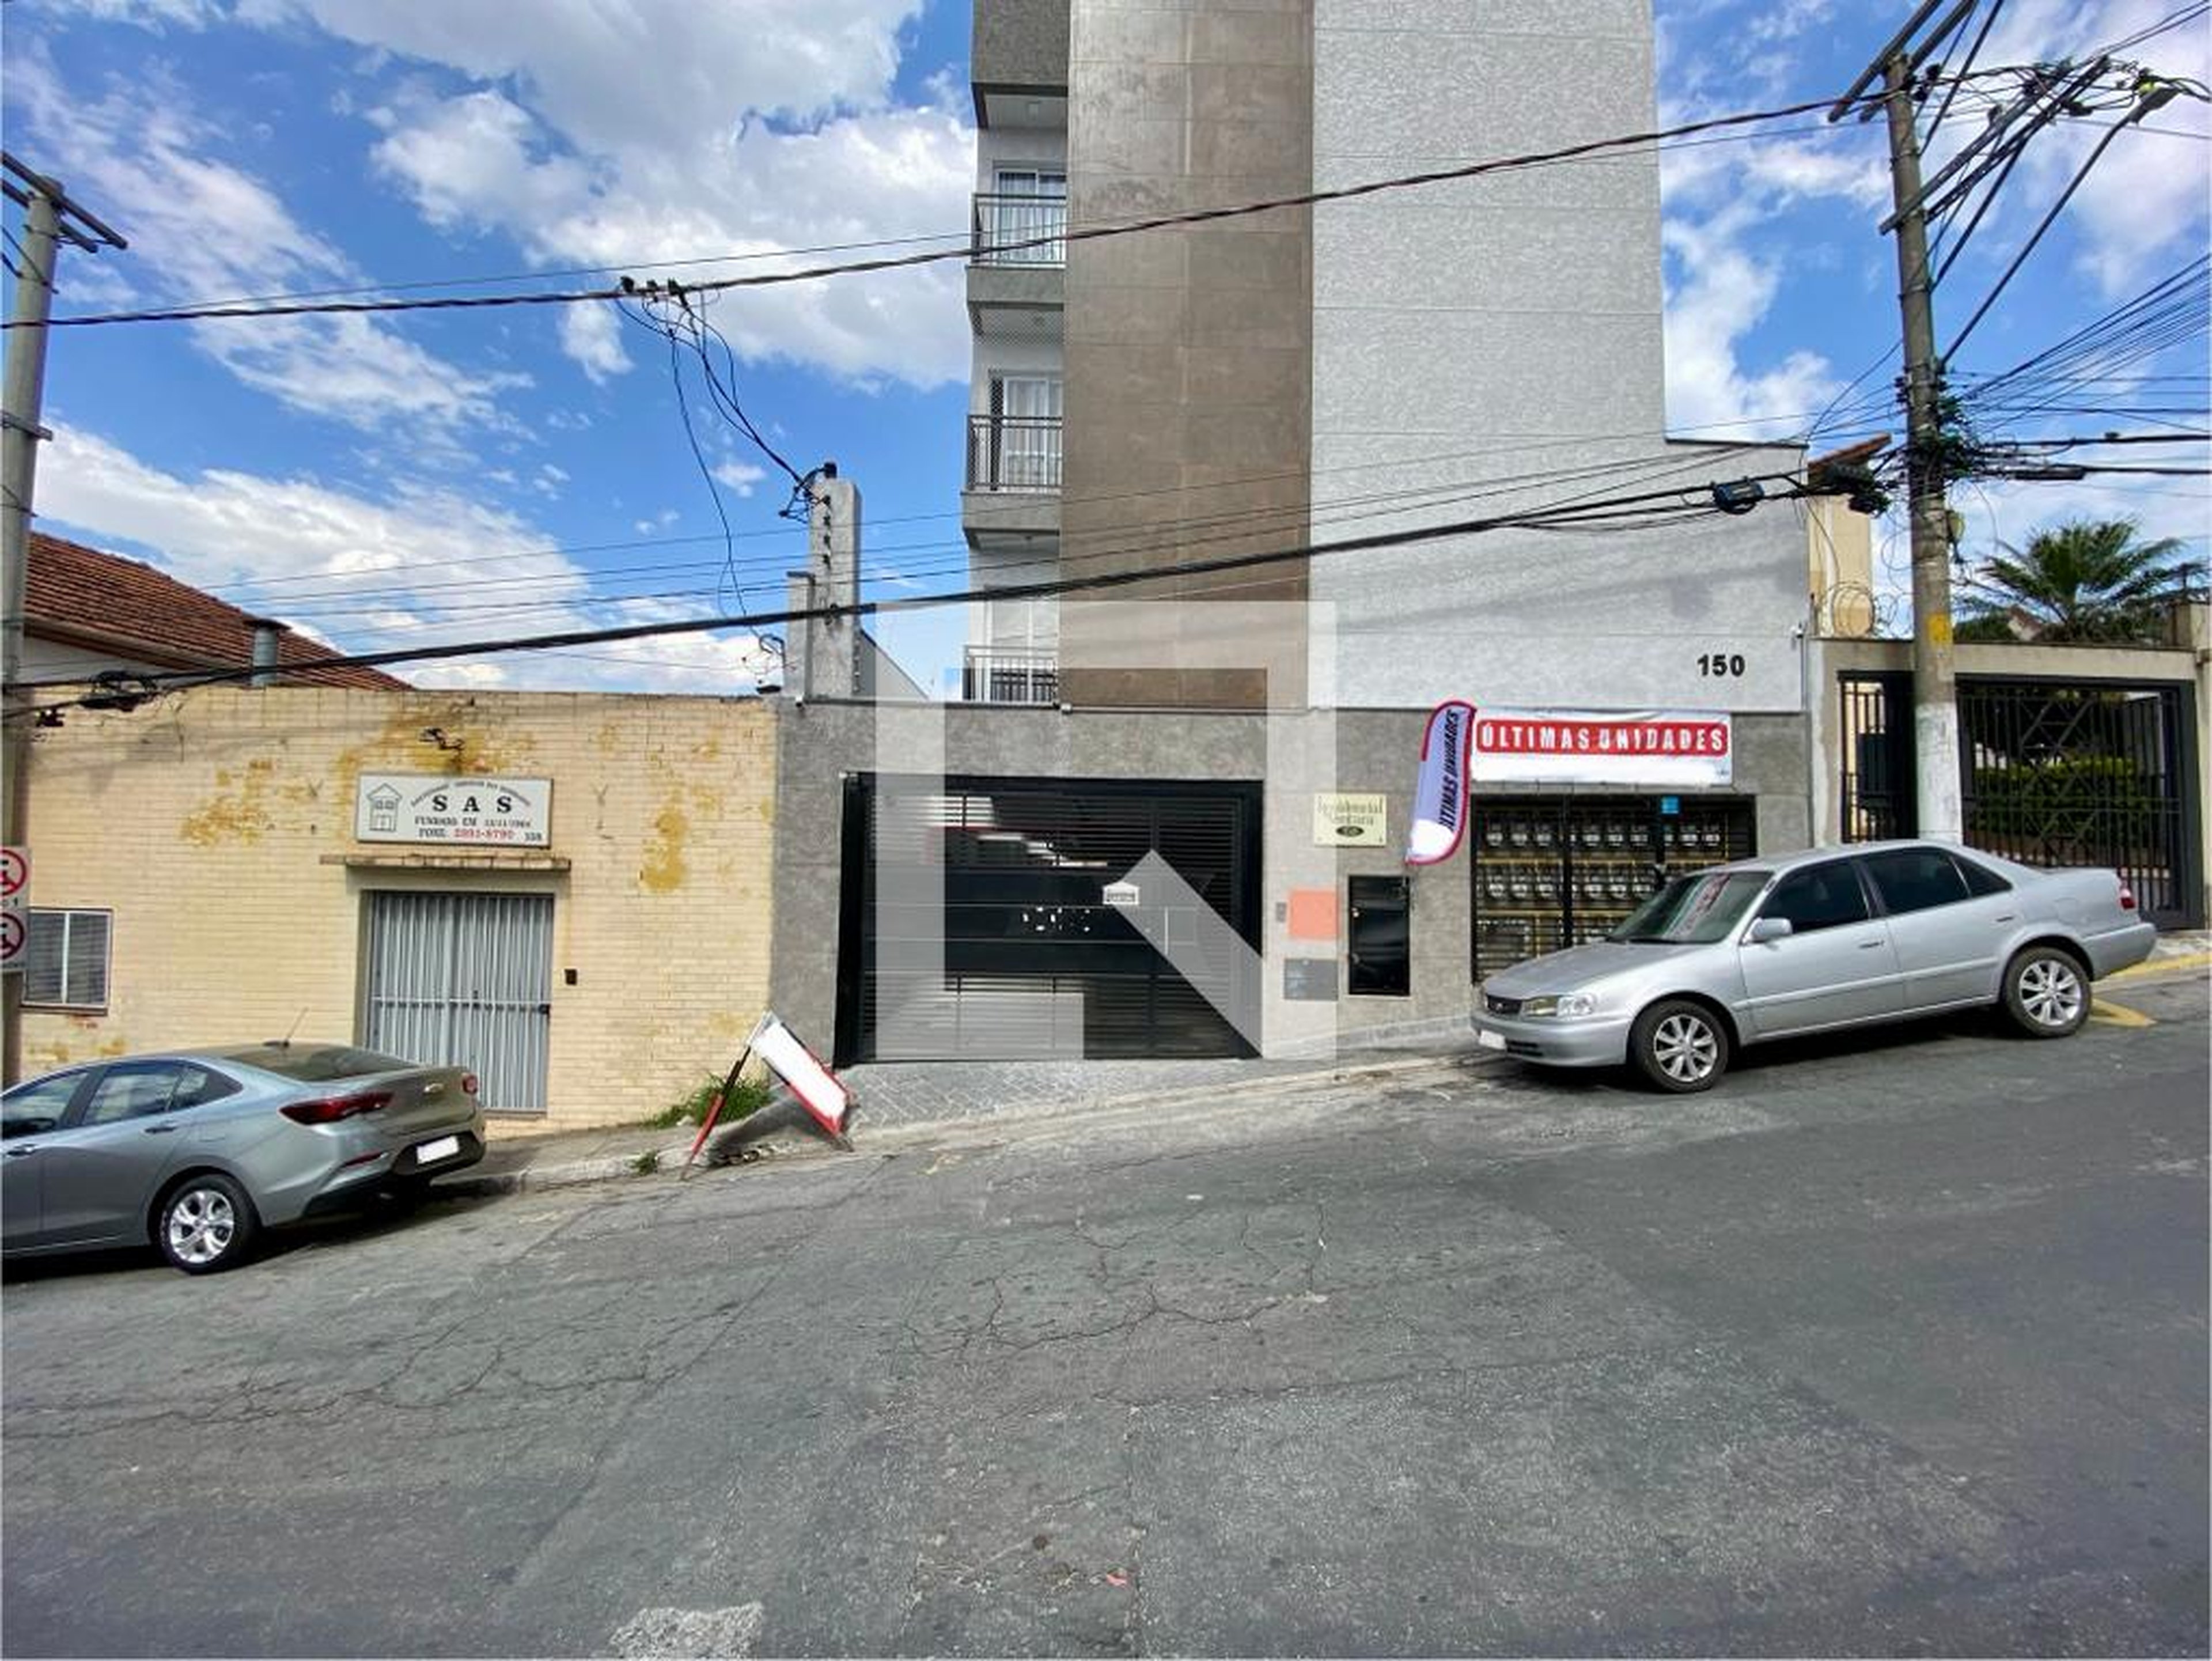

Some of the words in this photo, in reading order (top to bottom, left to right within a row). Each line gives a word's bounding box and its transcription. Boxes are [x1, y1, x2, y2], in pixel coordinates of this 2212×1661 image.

[1697, 654, 1745, 677] 150
[1444, 709, 1459, 777] UNIDADES
[1482, 722, 1589, 749] ÚLTIMAS
[1599, 728, 1723, 751] UNIDADES
